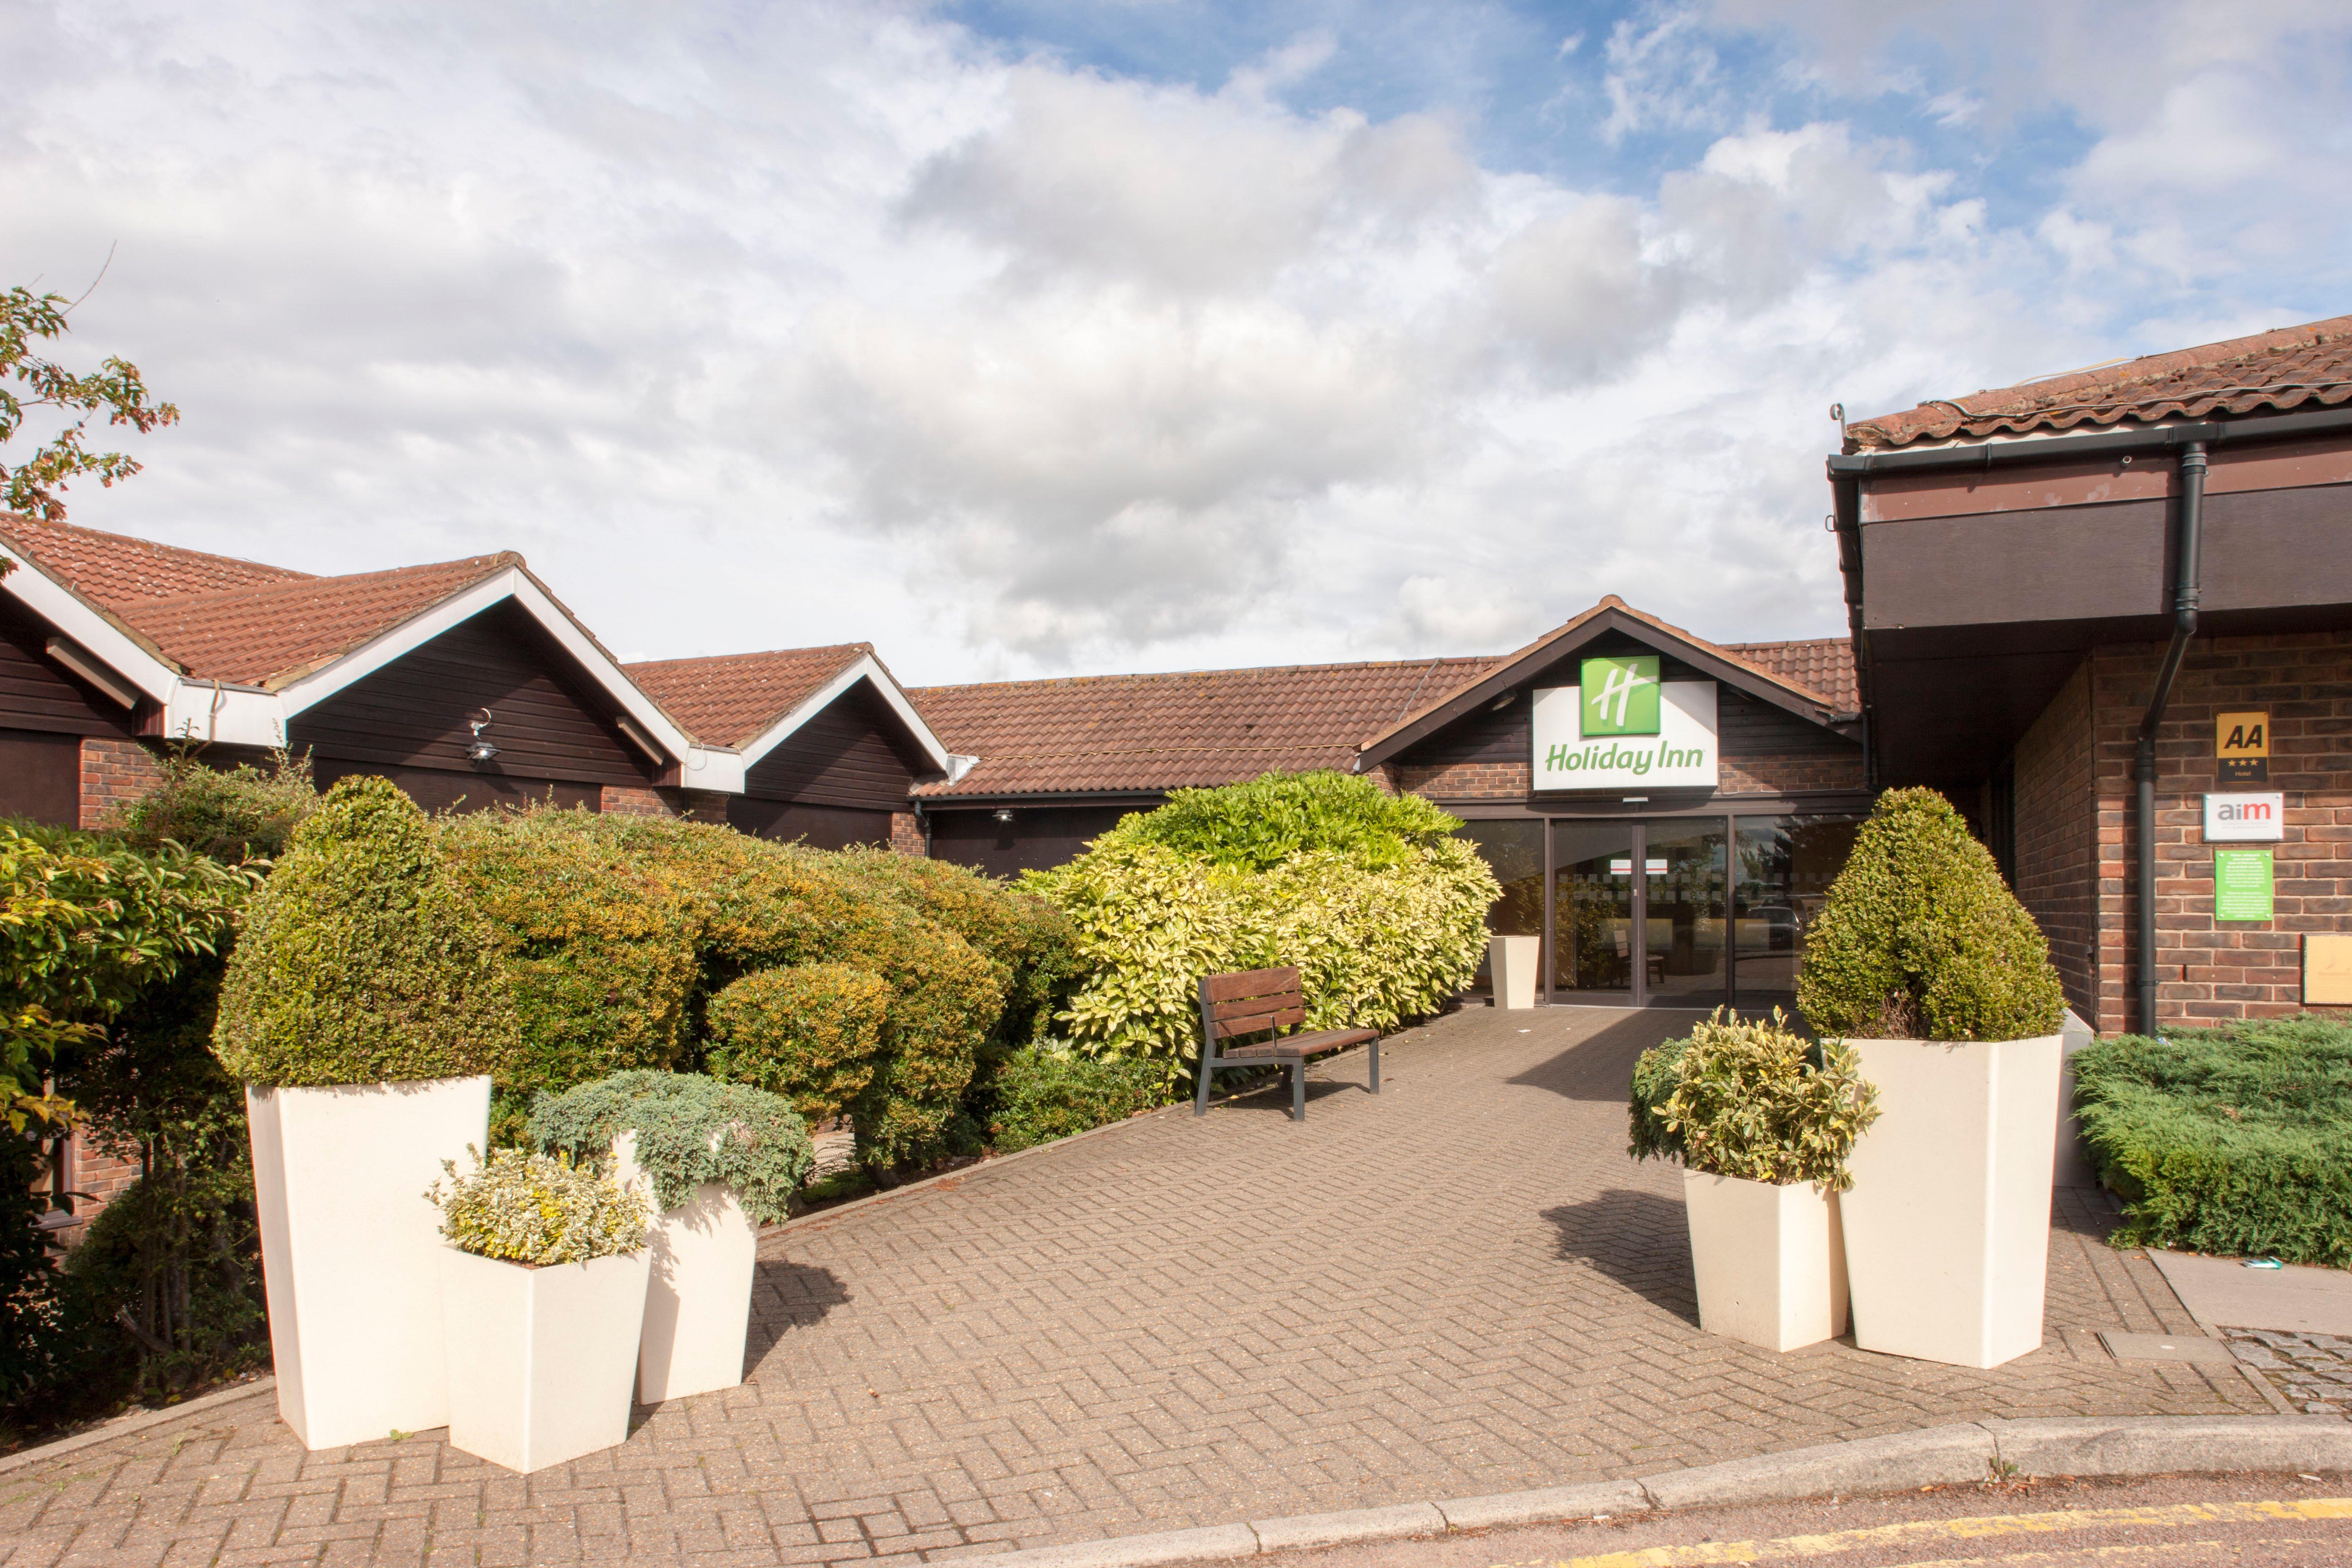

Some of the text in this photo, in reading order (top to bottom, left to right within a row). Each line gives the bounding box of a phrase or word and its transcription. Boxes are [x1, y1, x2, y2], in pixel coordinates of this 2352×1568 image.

[2224, 725, 2262, 749] AA
[1545, 741, 1703, 775] Holiday Inn
[2218, 803, 2271, 820] aim
